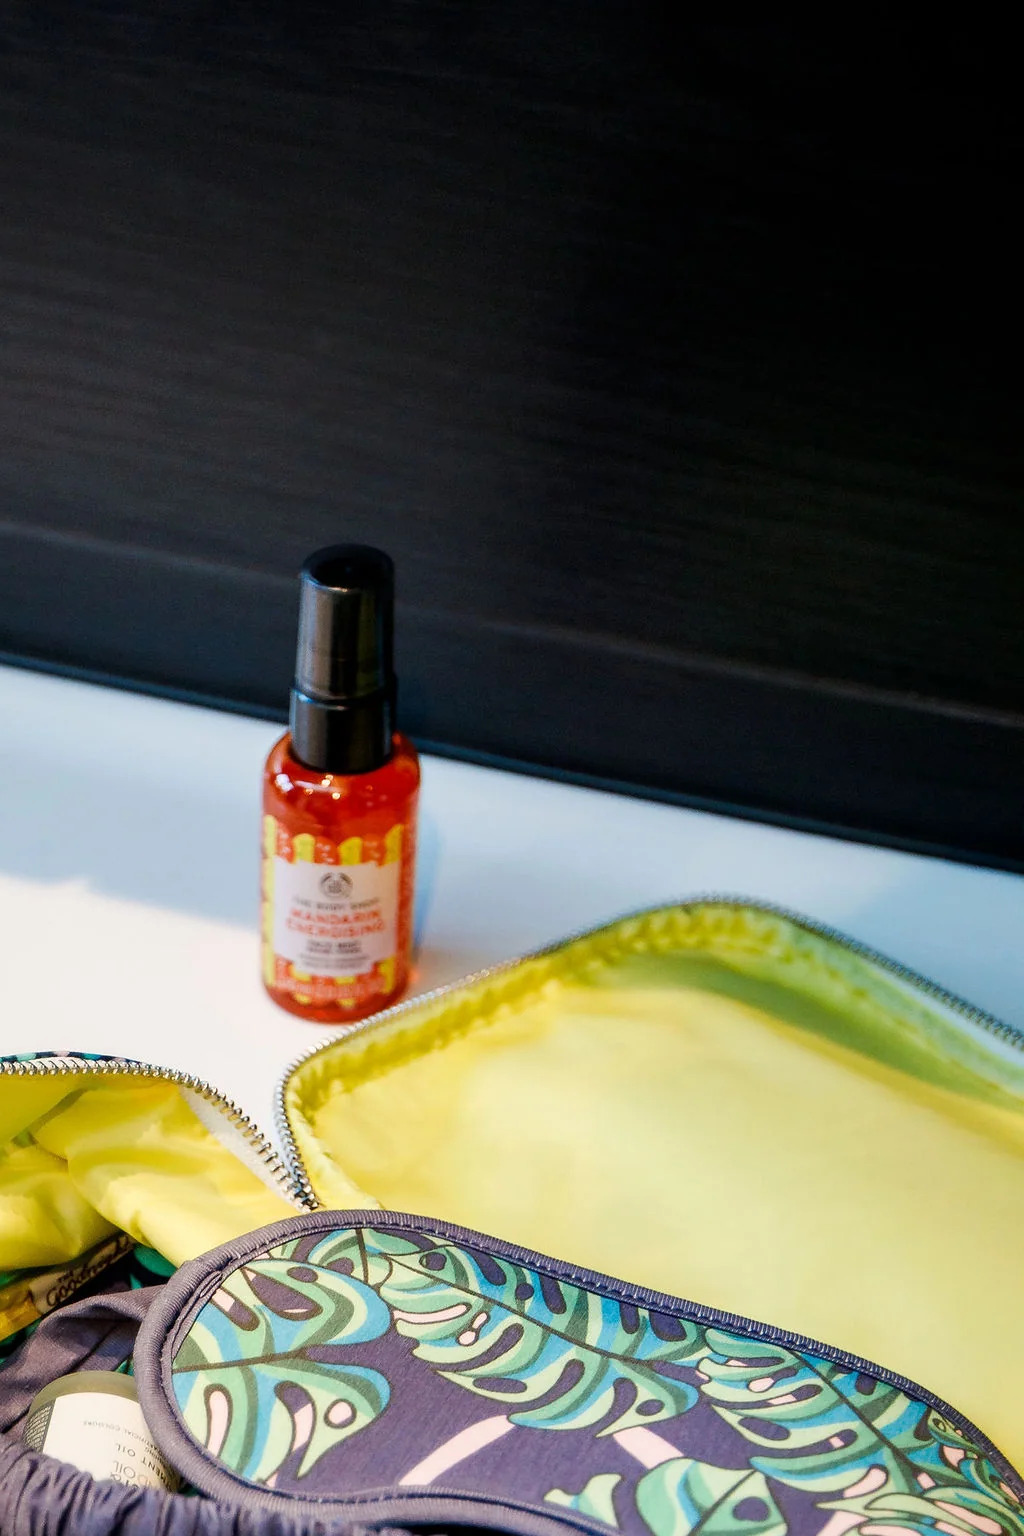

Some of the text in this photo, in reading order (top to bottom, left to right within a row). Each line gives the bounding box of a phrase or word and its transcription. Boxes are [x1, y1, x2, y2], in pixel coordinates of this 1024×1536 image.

[291, 908, 381, 925] MANDARIN
[115, 1442, 135, 1456] OIL
[112, 1459, 136, 1479] OIL
